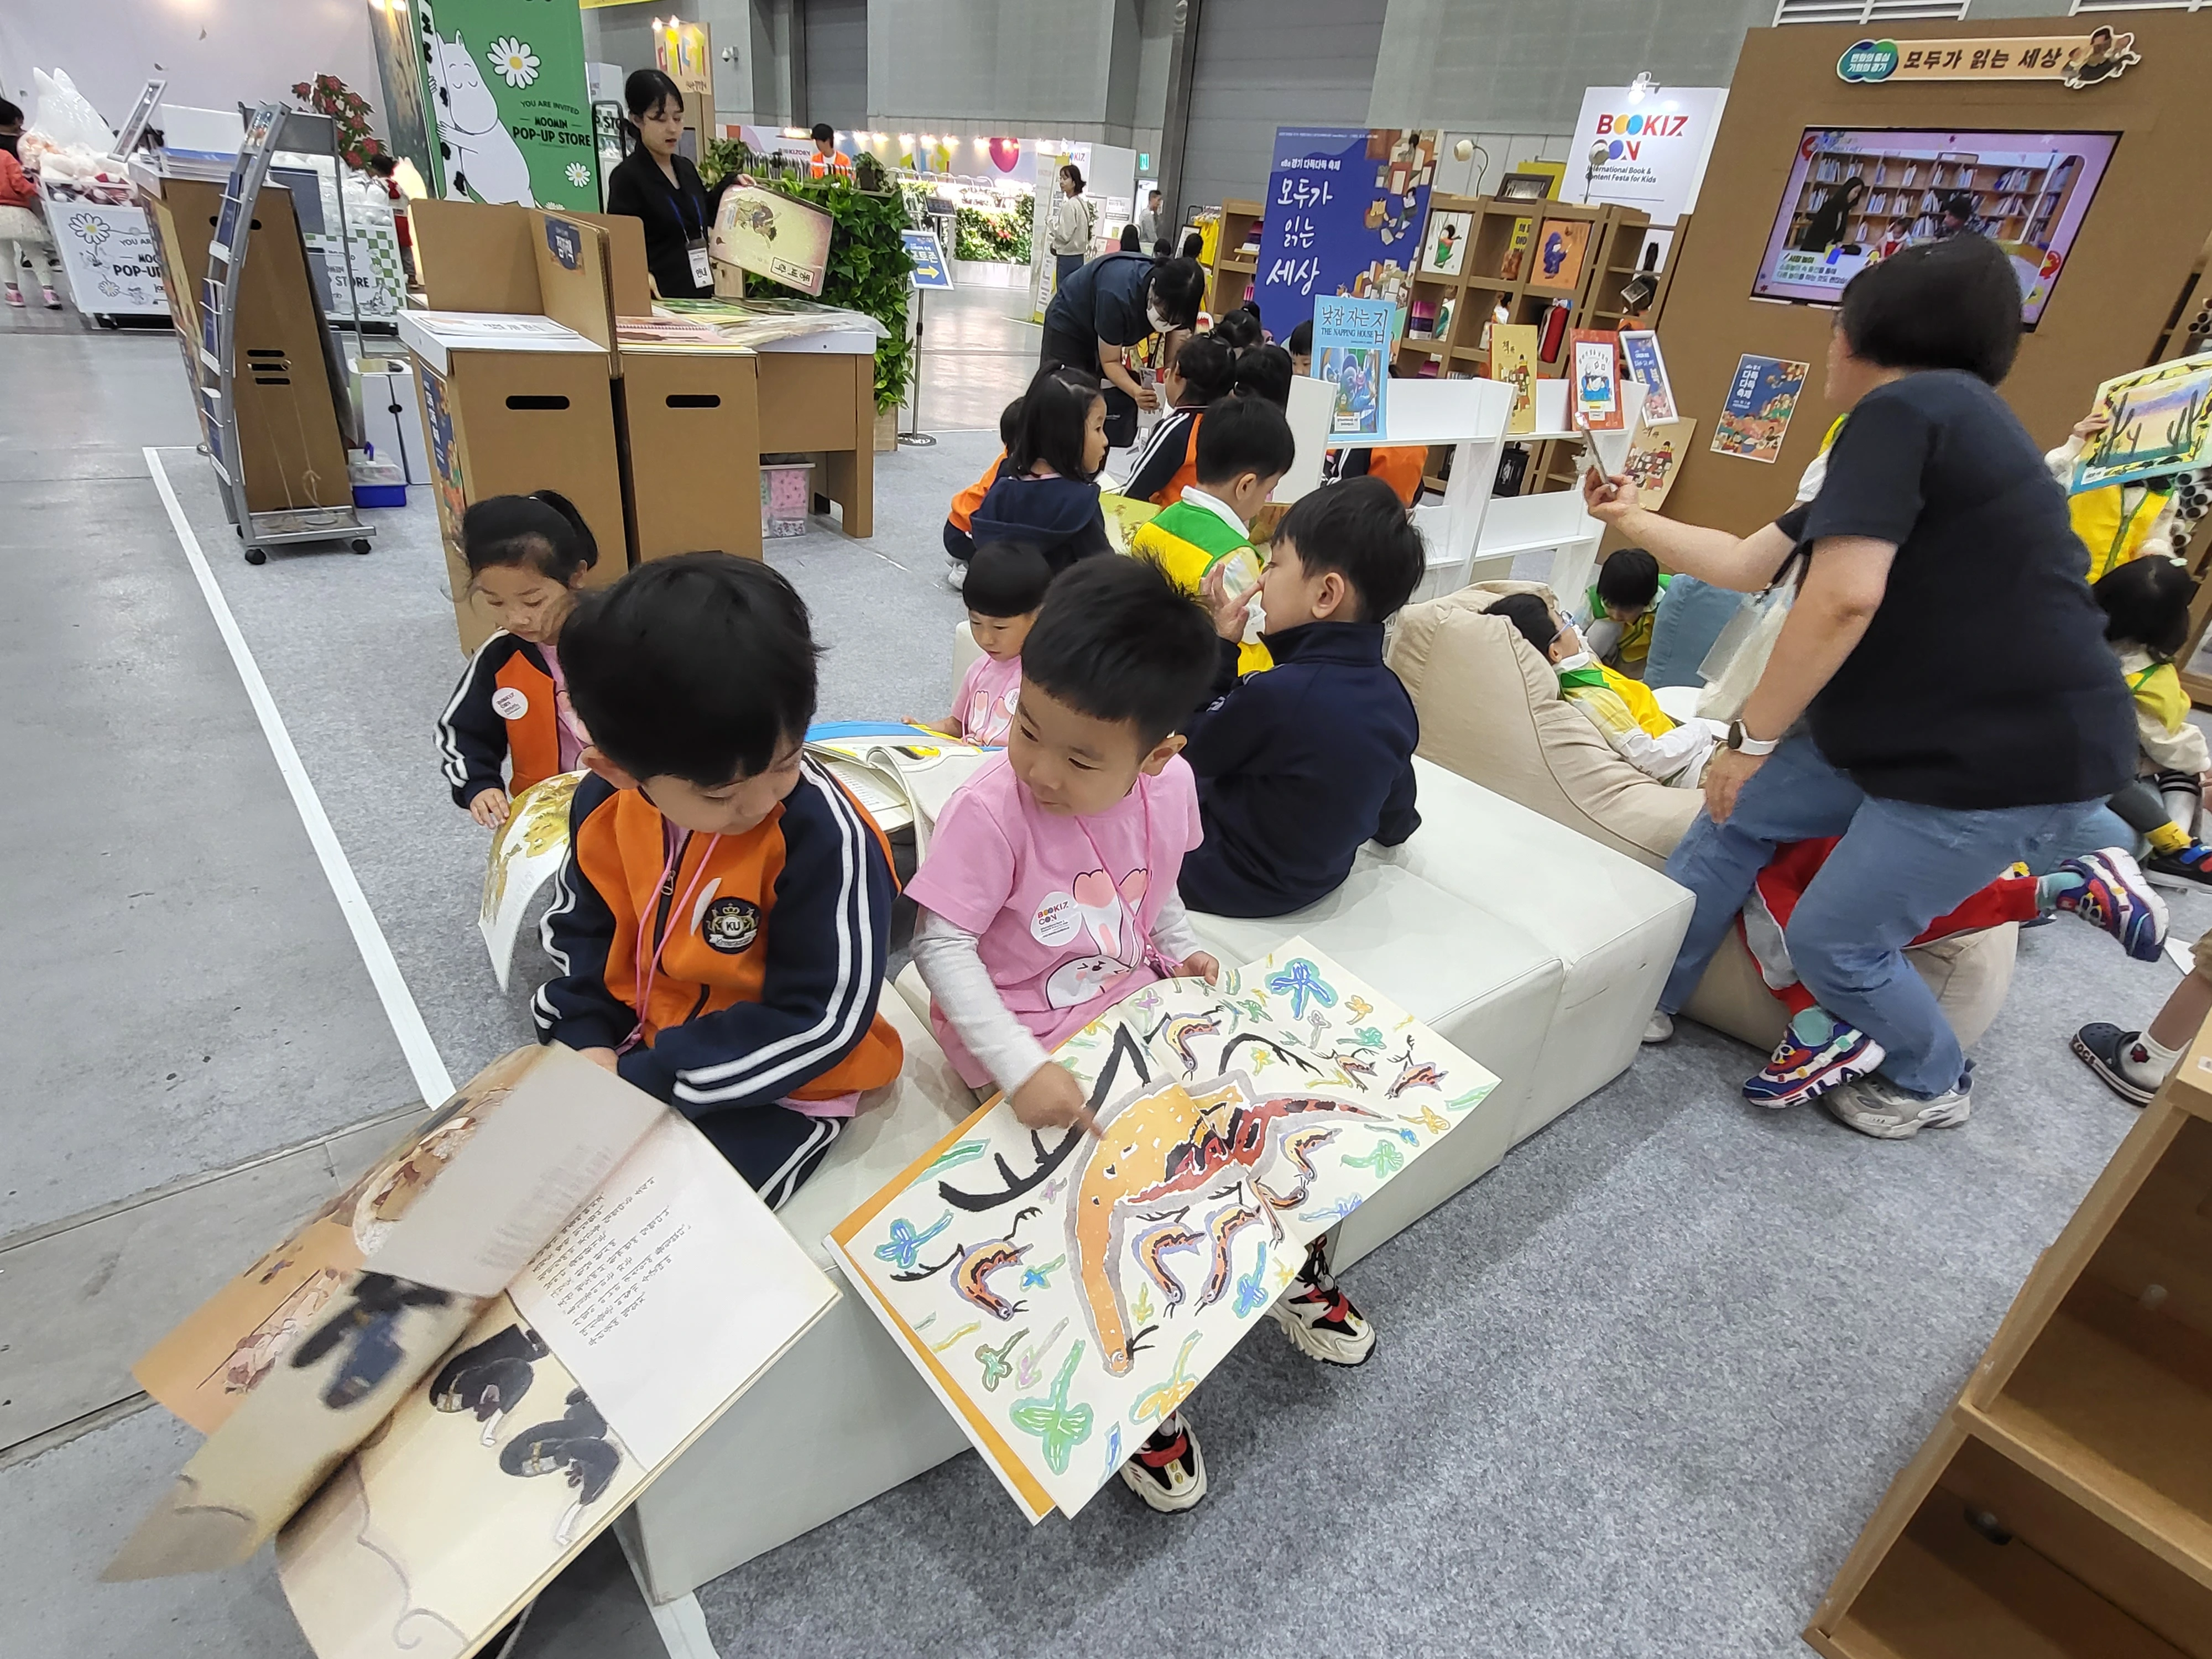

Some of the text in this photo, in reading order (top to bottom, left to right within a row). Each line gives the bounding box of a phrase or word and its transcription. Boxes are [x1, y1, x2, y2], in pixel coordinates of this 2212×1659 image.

[1850, 53, 1874, 62] 변화의
[1903, 47, 2063, 70] 모두가 읽는 세상
[1847, 63, 1887, 72] 기회의 경기
[553, 102, 580, 115] INVITED
[535, 116, 568, 129] MOOMIN
[1596, 114, 1689, 137] BOOKIZ
[512, 126, 555, 143] POP-UP
[558, 131, 591, 147] STORE
[1291, 158, 1303, 169] 경기
[1304, 159, 1327, 170] 다독다독
[1628, 166, 1645, 175] Book
[1611, 174, 1629, 182] Festa
[1631, 174, 1640, 182] for
[1641, 175, 1657, 184] Kids
[1277, 178, 1333, 209] 모두가
[1284, 215, 1315, 248] 읽는
[120, 238, 137, 247] YOU
[1265, 257, 1321, 296] 세상
[1322, 305, 1389, 345] 낮잠 자는 집
[1321, 327, 1374, 338] THE NAPPING HOUSE
[1741, 369, 1759, 380] 다독
[1739, 379, 1756, 390] 다독
[1037, 901, 1069, 919] BOOKIZ
[1039, 914, 1057, 925] CON
[726, 921, 741, 931] KU
